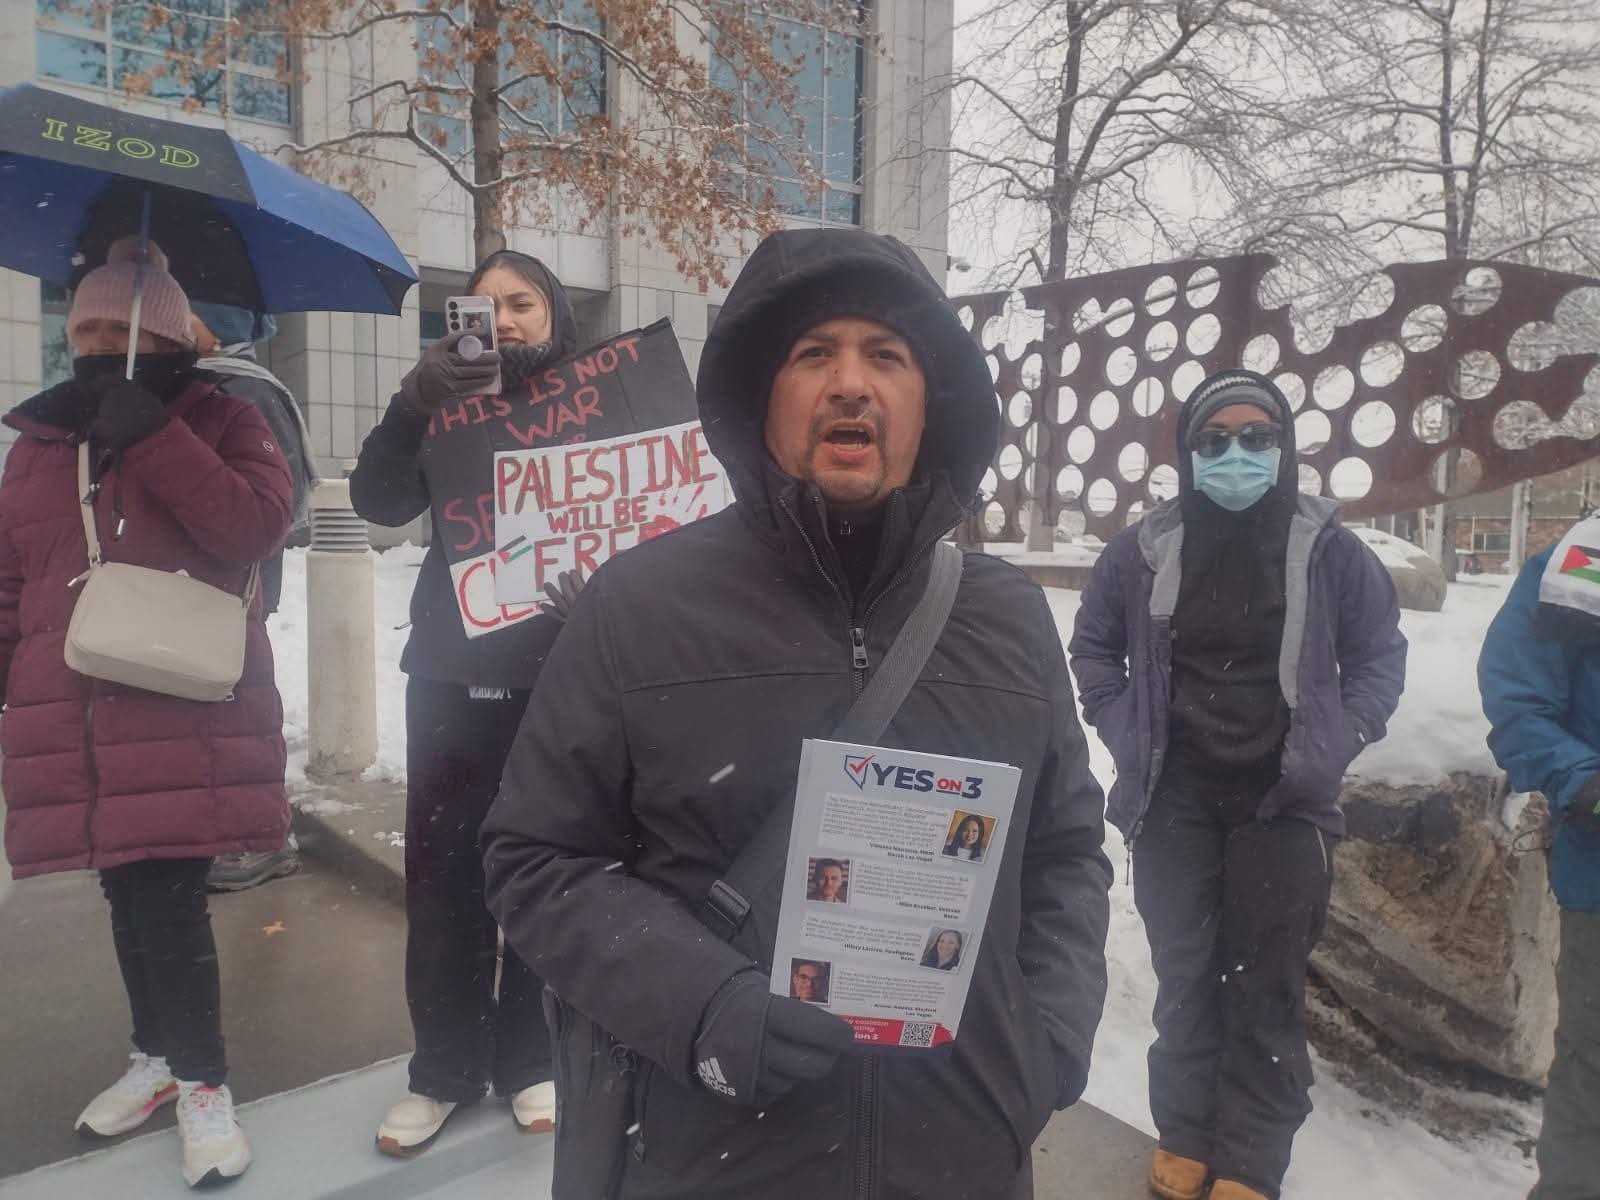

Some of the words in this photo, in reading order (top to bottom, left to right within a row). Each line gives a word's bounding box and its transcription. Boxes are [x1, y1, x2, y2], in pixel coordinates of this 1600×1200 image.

[41, 118, 200, 168] IZOD
[528, 368, 566, 406] IS
[573, 337, 641, 382] NOT
[504, 386, 604, 446] WAR
[495, 427, 718, 515] PALESTINE
[546, 503, 612, 534] WILL
[613, 495, 649, 527] BE
[534, 524, 652, 592] FR
[871, 762, 935, 793] YES
[936, 777, 963, 793] ON
[961, 776, 984, 799] 3
